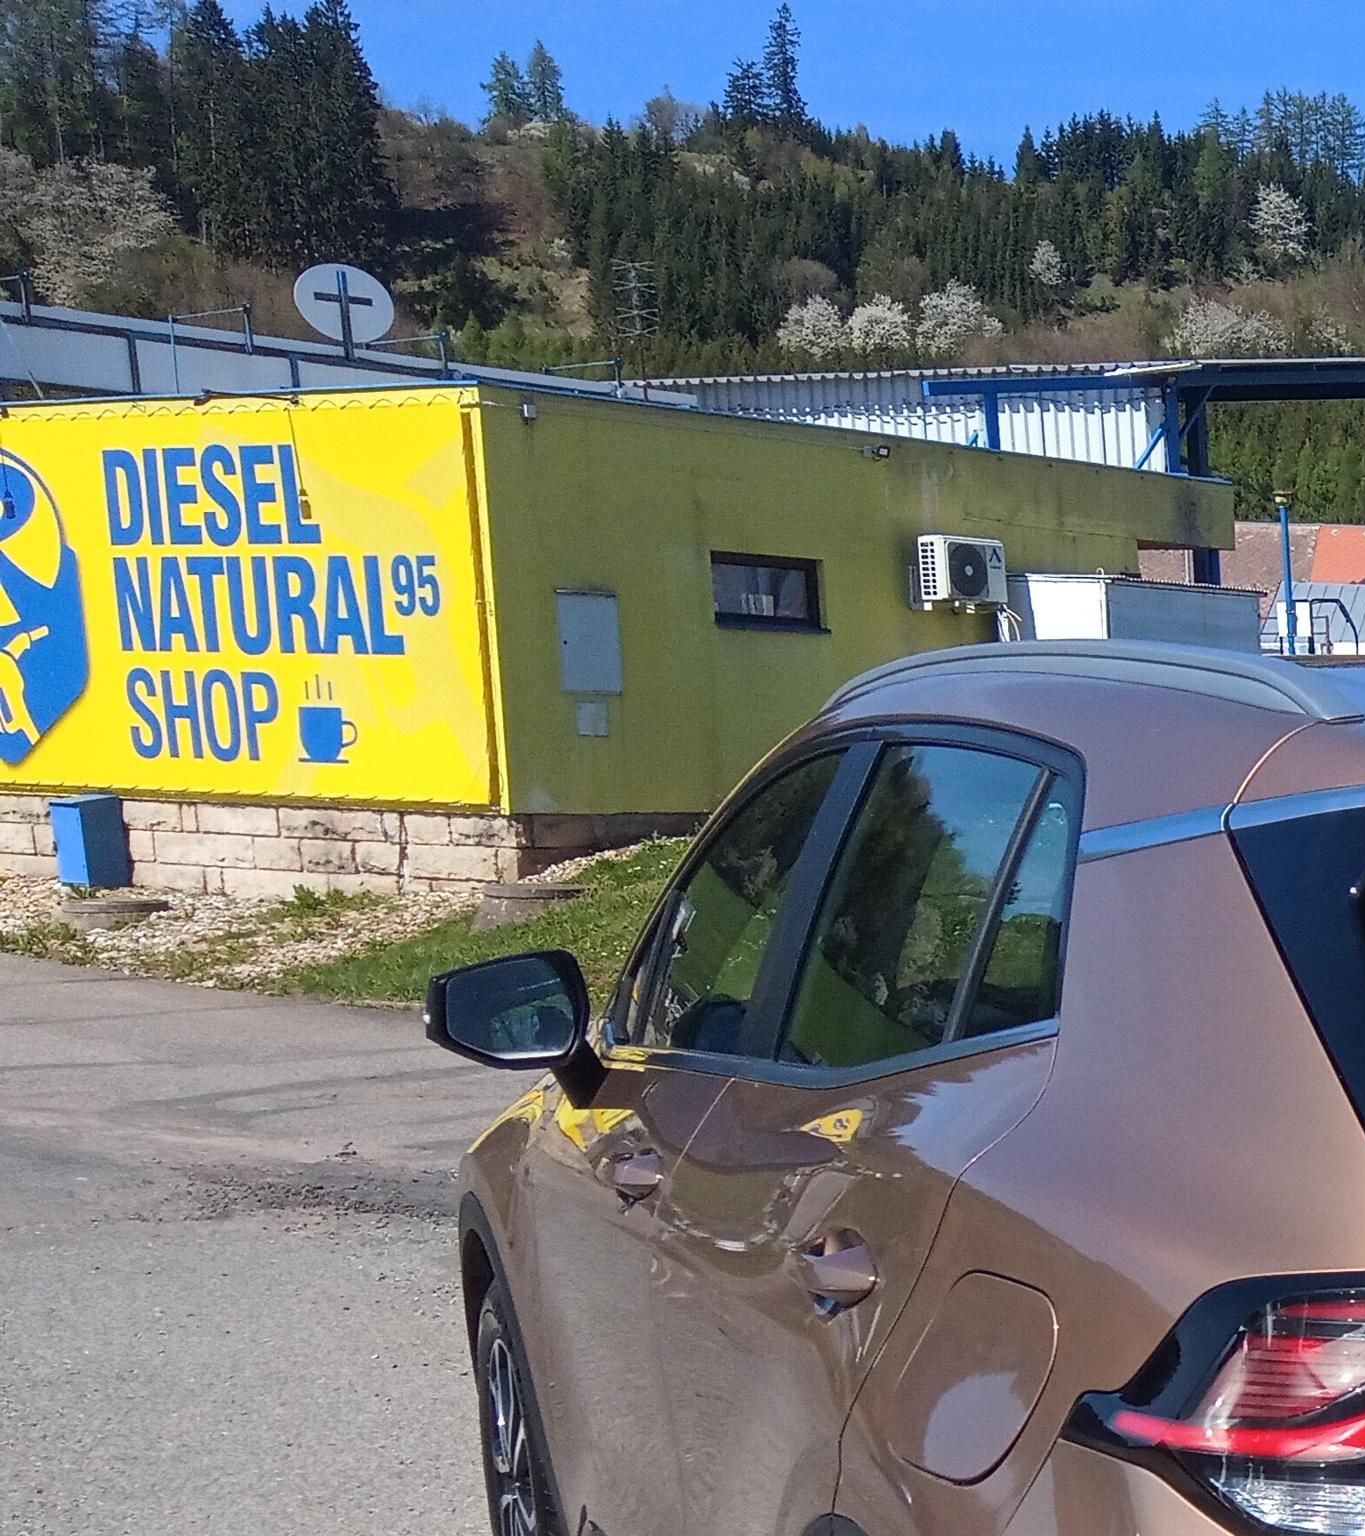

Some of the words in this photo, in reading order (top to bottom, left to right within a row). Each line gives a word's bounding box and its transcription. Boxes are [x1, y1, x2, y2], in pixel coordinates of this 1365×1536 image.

[102, 444, 321, 545] DIESEL
[112, 556, 405, 655] NATURAL
[391, 555, 440, 618] 95
[127, 669, 278, 761] SHOP
